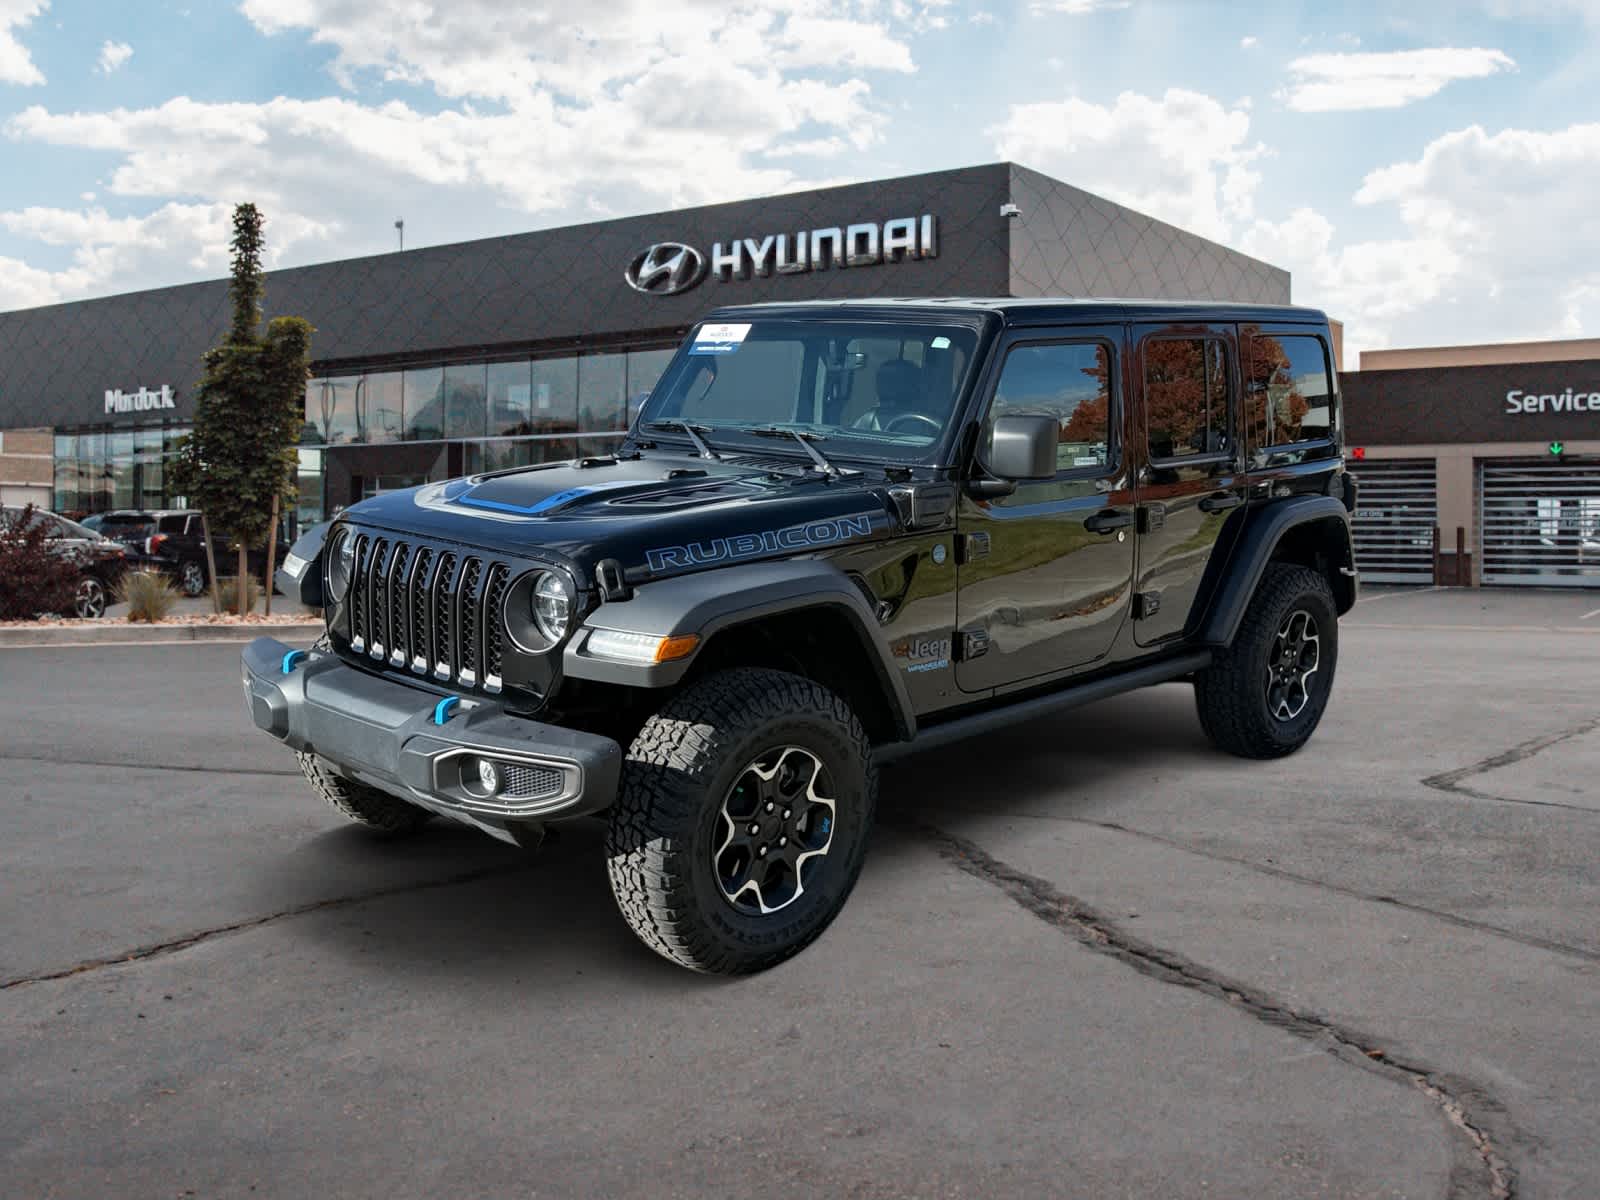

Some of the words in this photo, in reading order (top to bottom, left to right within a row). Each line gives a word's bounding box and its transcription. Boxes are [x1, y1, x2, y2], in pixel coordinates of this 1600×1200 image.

[711, 213, 938, 283] HYUNDAI
[104, 384, 175, 413] Murdock
[1506, 387, 1600, 413] Service
[646, 515, 872, 571] RUBICON
[908, 638, 949, 660] Jeep
